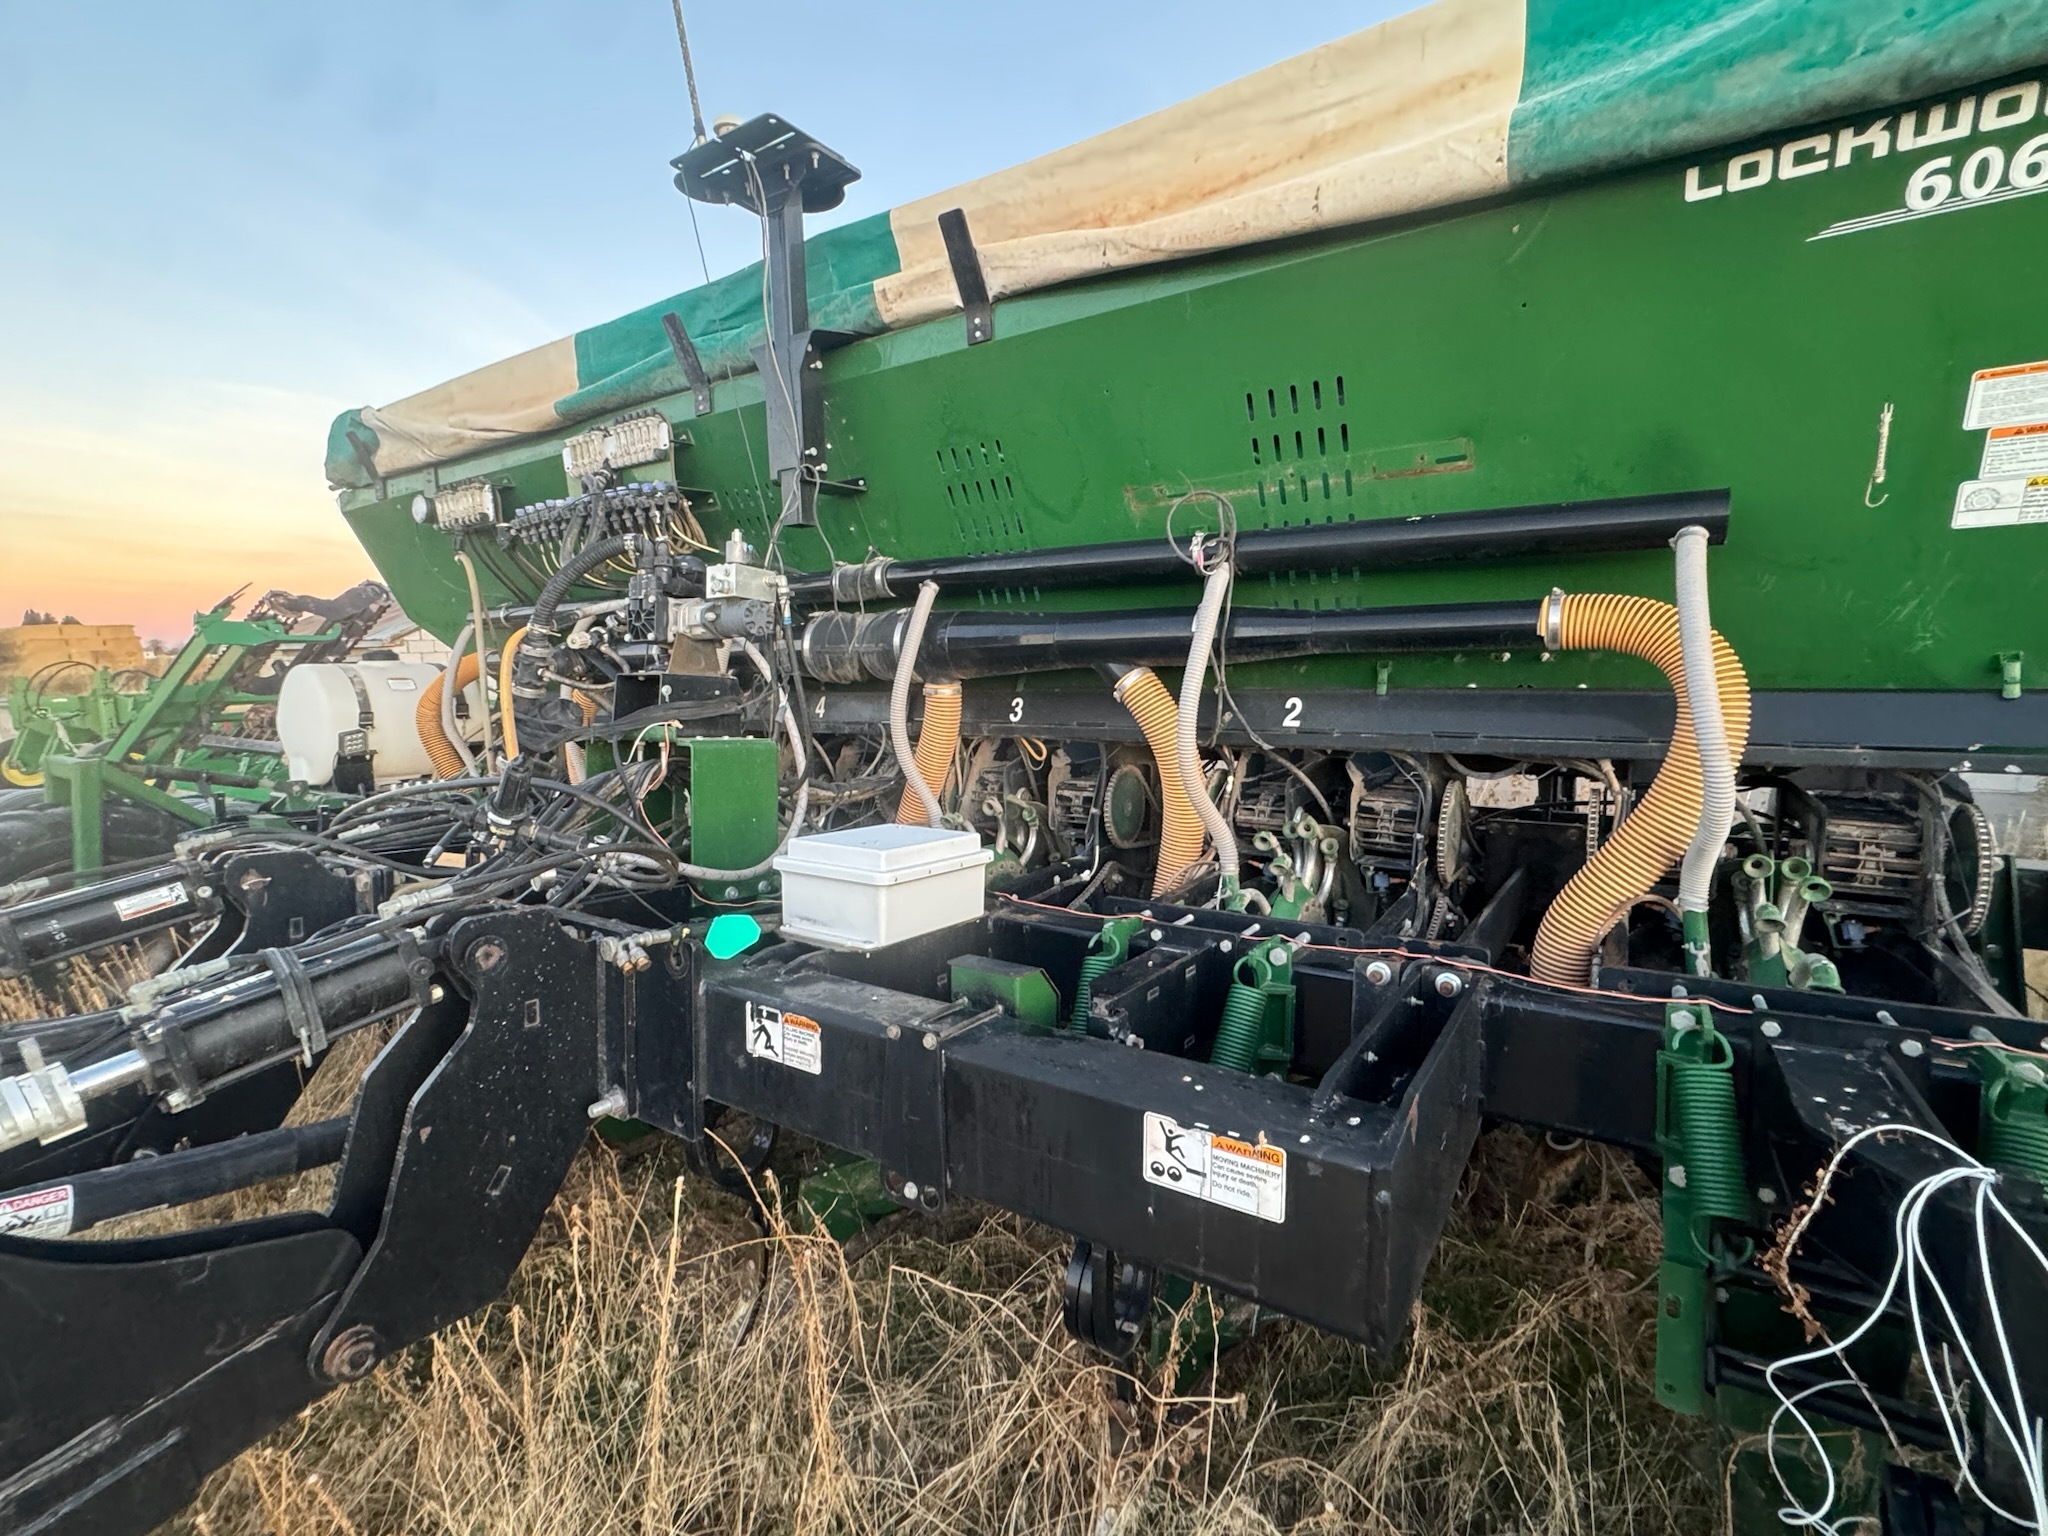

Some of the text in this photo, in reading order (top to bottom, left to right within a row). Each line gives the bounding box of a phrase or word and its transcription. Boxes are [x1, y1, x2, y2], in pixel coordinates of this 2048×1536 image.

[1684, 80, 2048, 203] LOCKWO
[1904, 133, 2048, 212] 606
[815, 695, 827, 719] 4
[1009, 697, 1024, 723] 3
[1282, 696, 1303, 727] 2
[1224, 1143, 1280, 1164] WARNING
[1212, 1162, 1267, 1184] Can cause severe
[1213, 1154, 1281, 1180] MOVING MACHINERY
[13, 1189, 67, 1210] DANGER
[1212, 1181, 1223, 1189] Do
[1224, 1184, 1235, 1193] not
